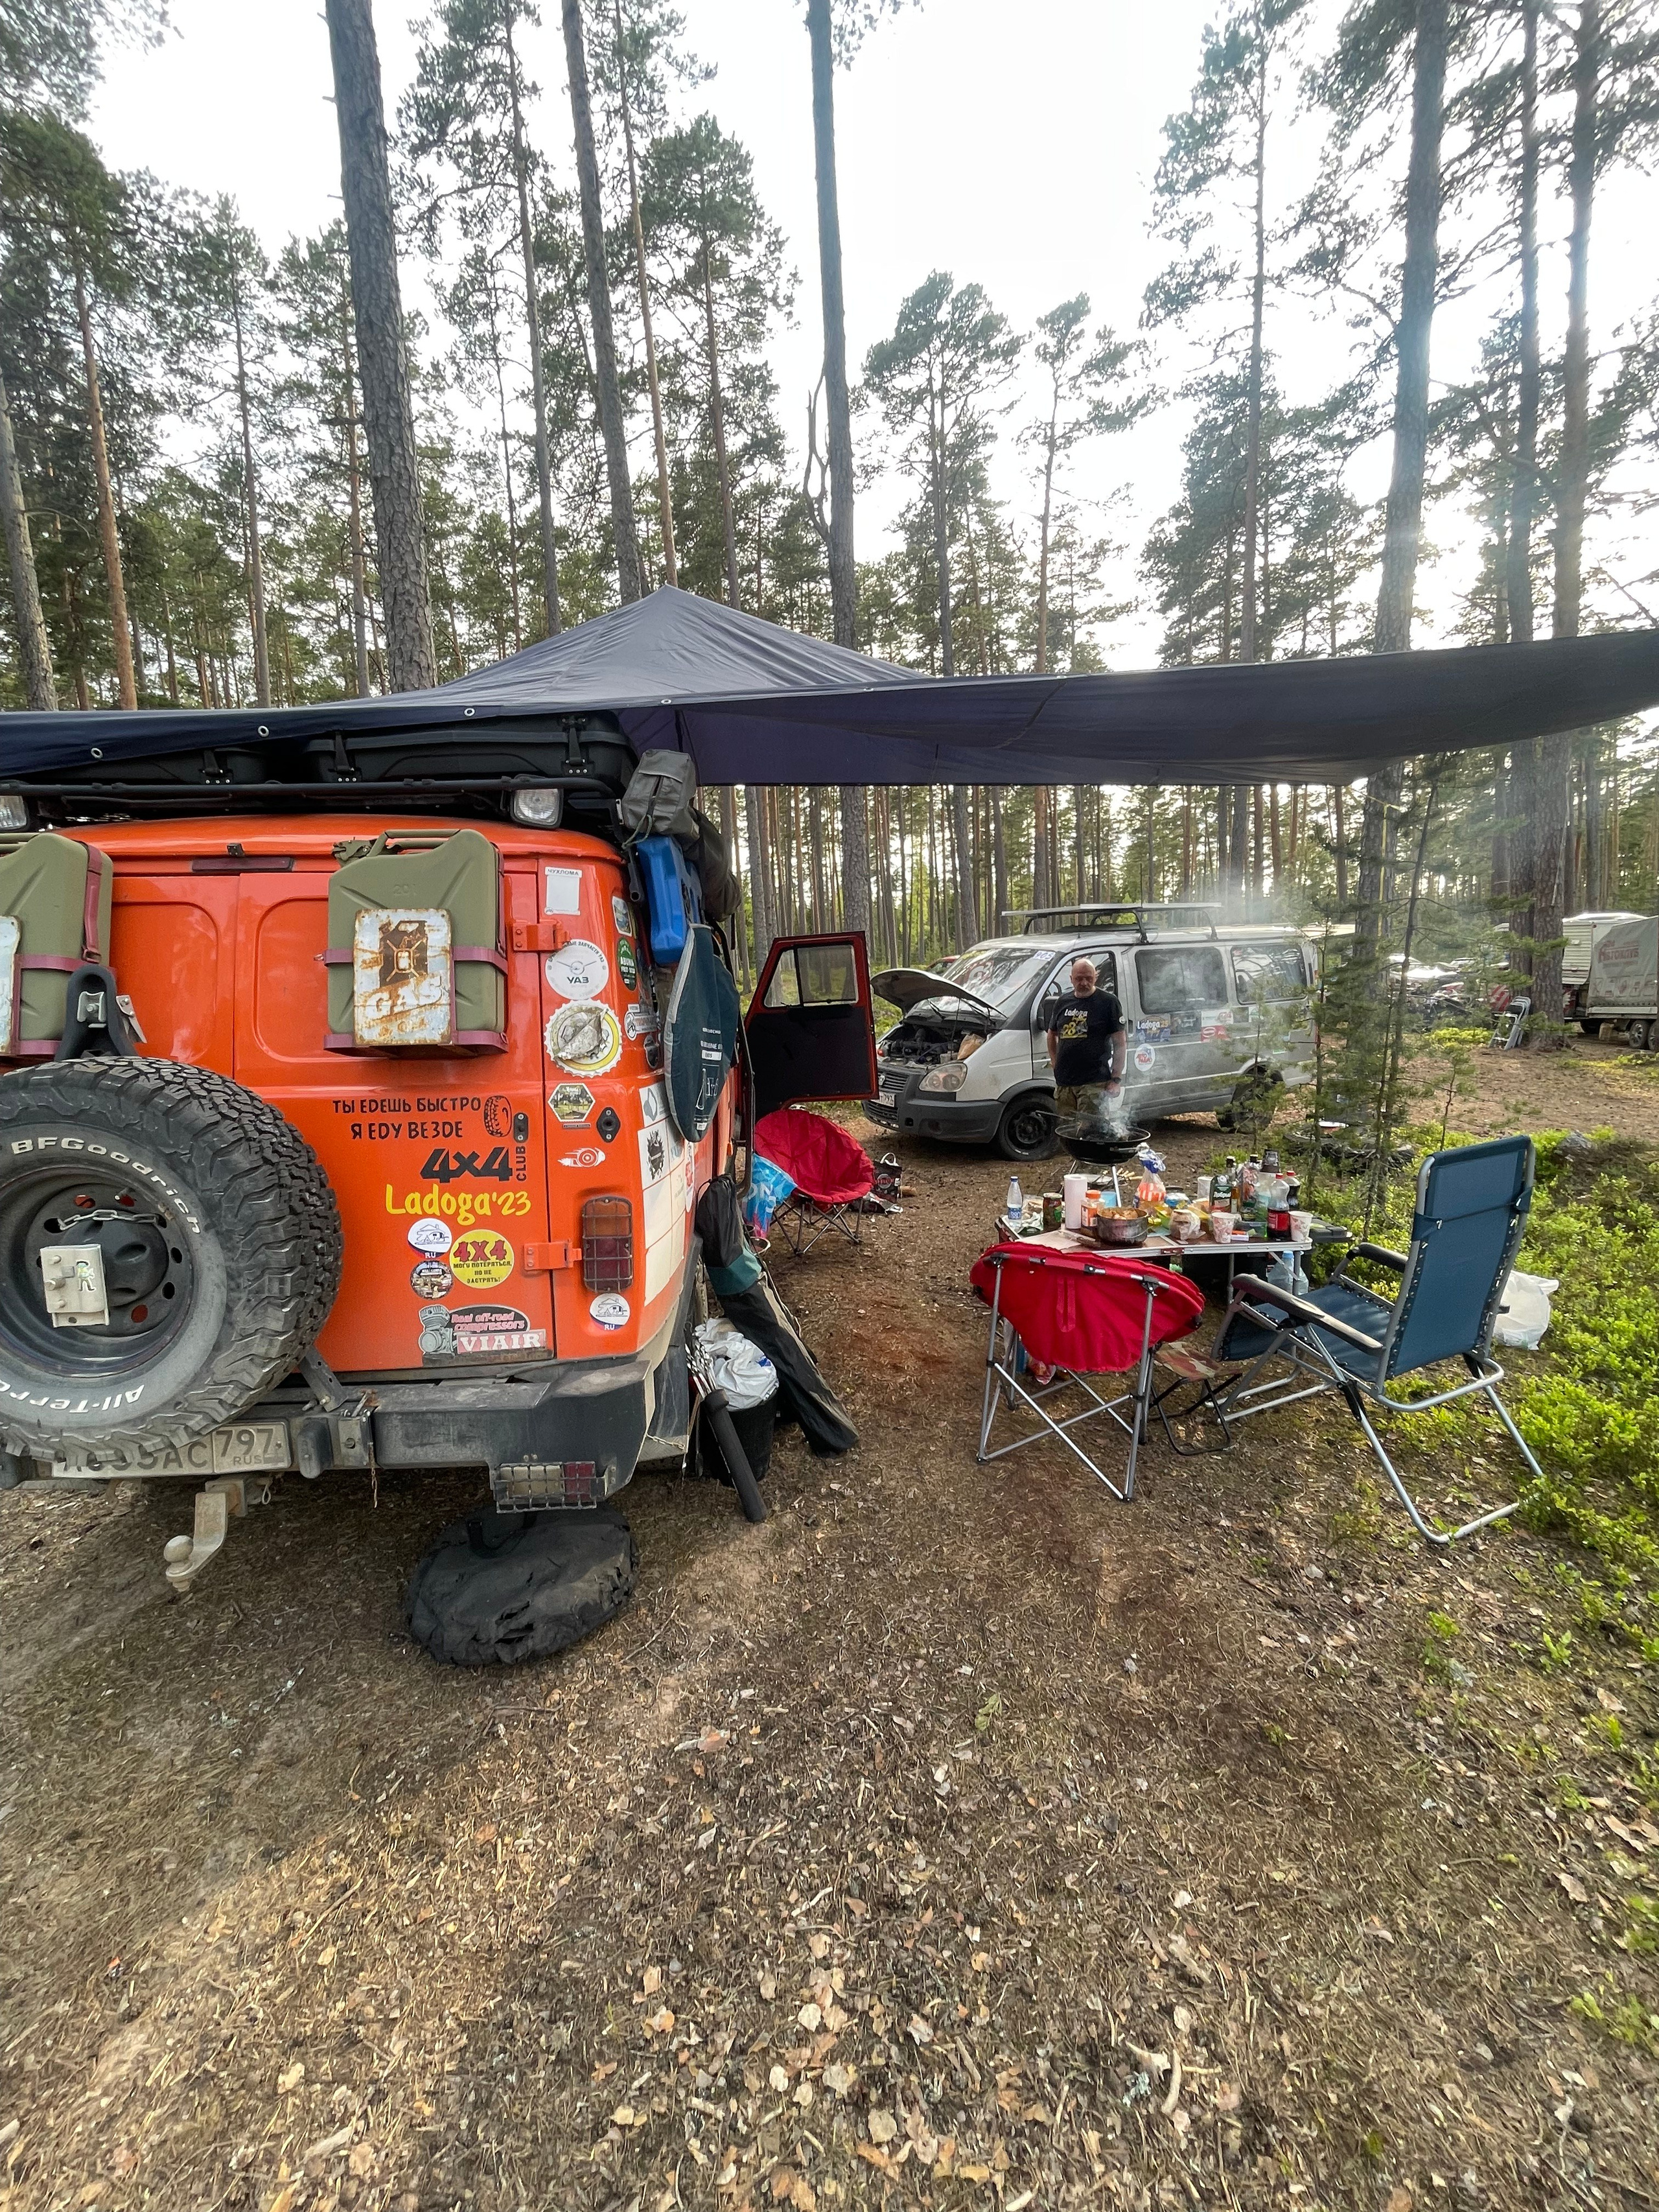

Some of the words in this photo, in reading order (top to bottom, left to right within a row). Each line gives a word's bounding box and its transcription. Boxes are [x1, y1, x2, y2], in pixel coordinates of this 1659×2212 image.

[366, 974, 443, 1020] GAS
[1064, 1008, 1088, 1018] Ladoga
[1137, 1020, 1160, 1030] Ladoga
[332, 1100, 355, 1113] ТЫ
[416, 1097, 481, 1113] БЫСТРО
[351, 1123, 362, 1139] Я
[516, 1146, 526, 1182] CLUB
[11, 1137, 202, 1234] BFGoodrich
[385, 1184, 531, 1226] Ladoga'23
[451, 1313, 473, 1323] Real
[475, 1312, 515, 1322] off-road
[454, 1320, 525, 1333] compressors
[460, 1333, 542, 1352] VIAIR
[216, 1428, 273, 1458] 797
[233, 1456, 263, 1466] RUS
